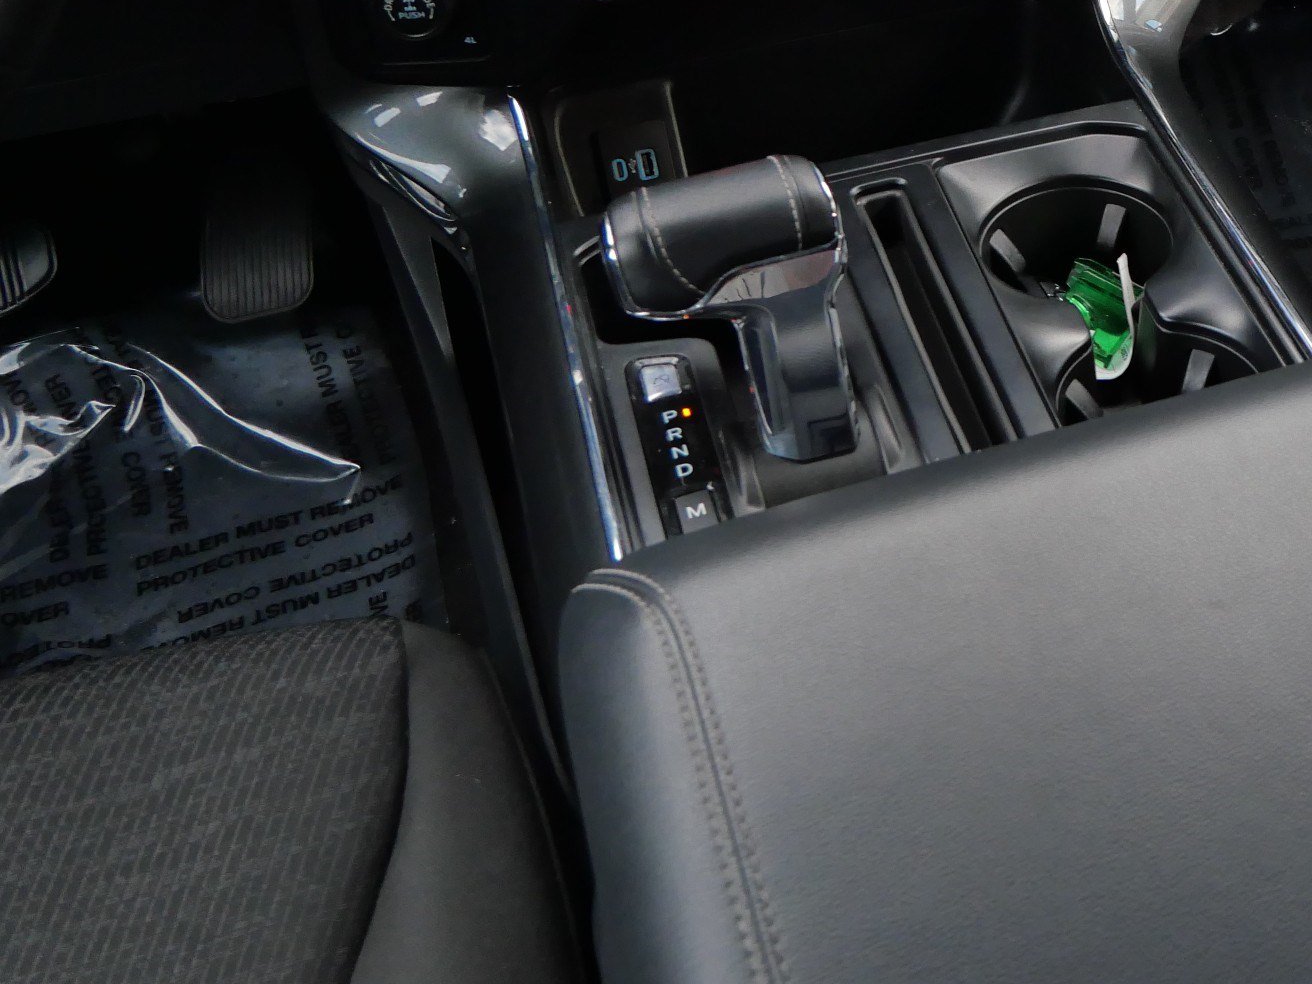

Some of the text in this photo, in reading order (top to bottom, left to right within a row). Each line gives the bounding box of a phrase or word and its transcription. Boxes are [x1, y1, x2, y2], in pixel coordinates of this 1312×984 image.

[304, 342, 338, 398] MUST
[662, 410, 677, 424] P
[666, 427, 682, 442] R
[671, 444, 689, 459] N
[676, 463, 693, 478] D
[134, 474, 403, 570] DEALER MUST REMOVE
[686, 502, 707, 519] M
[136, 513, 374, 597] PROTECTIVE COVER
[177, 532, 413, 623] PROTECTIVE COVER
[326, 554, 416, 599] DEALER
[1, 599, 70, 628] OVER
[251, 591, 320, 626] MUST
